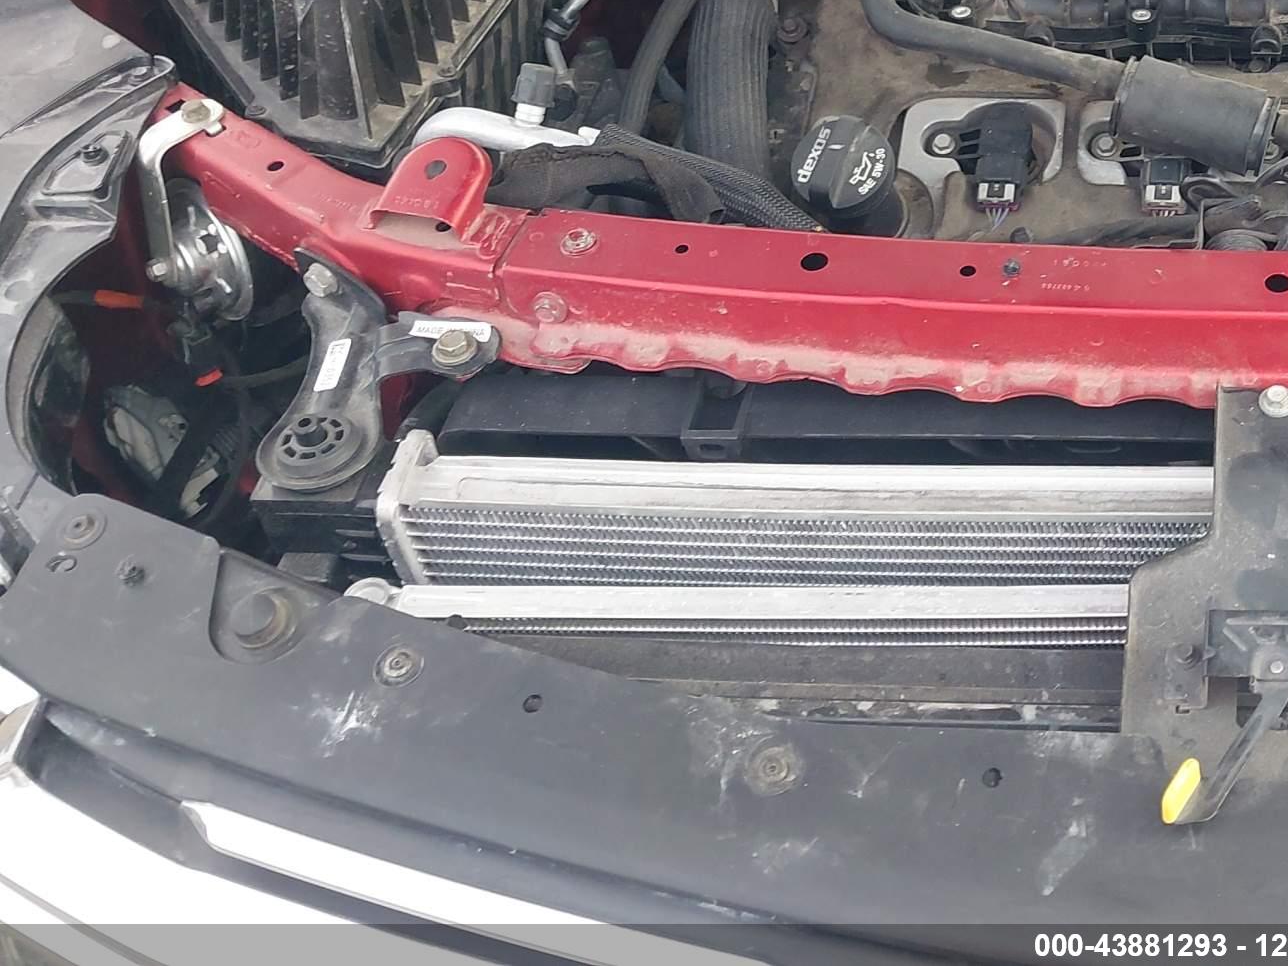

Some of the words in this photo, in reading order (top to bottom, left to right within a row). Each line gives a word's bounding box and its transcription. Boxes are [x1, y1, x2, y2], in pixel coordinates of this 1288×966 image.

[797, 125, 831, 183] dexos
[858, 177, 877, 195] SAE
[871, 147, 886, 178] 5W-30
